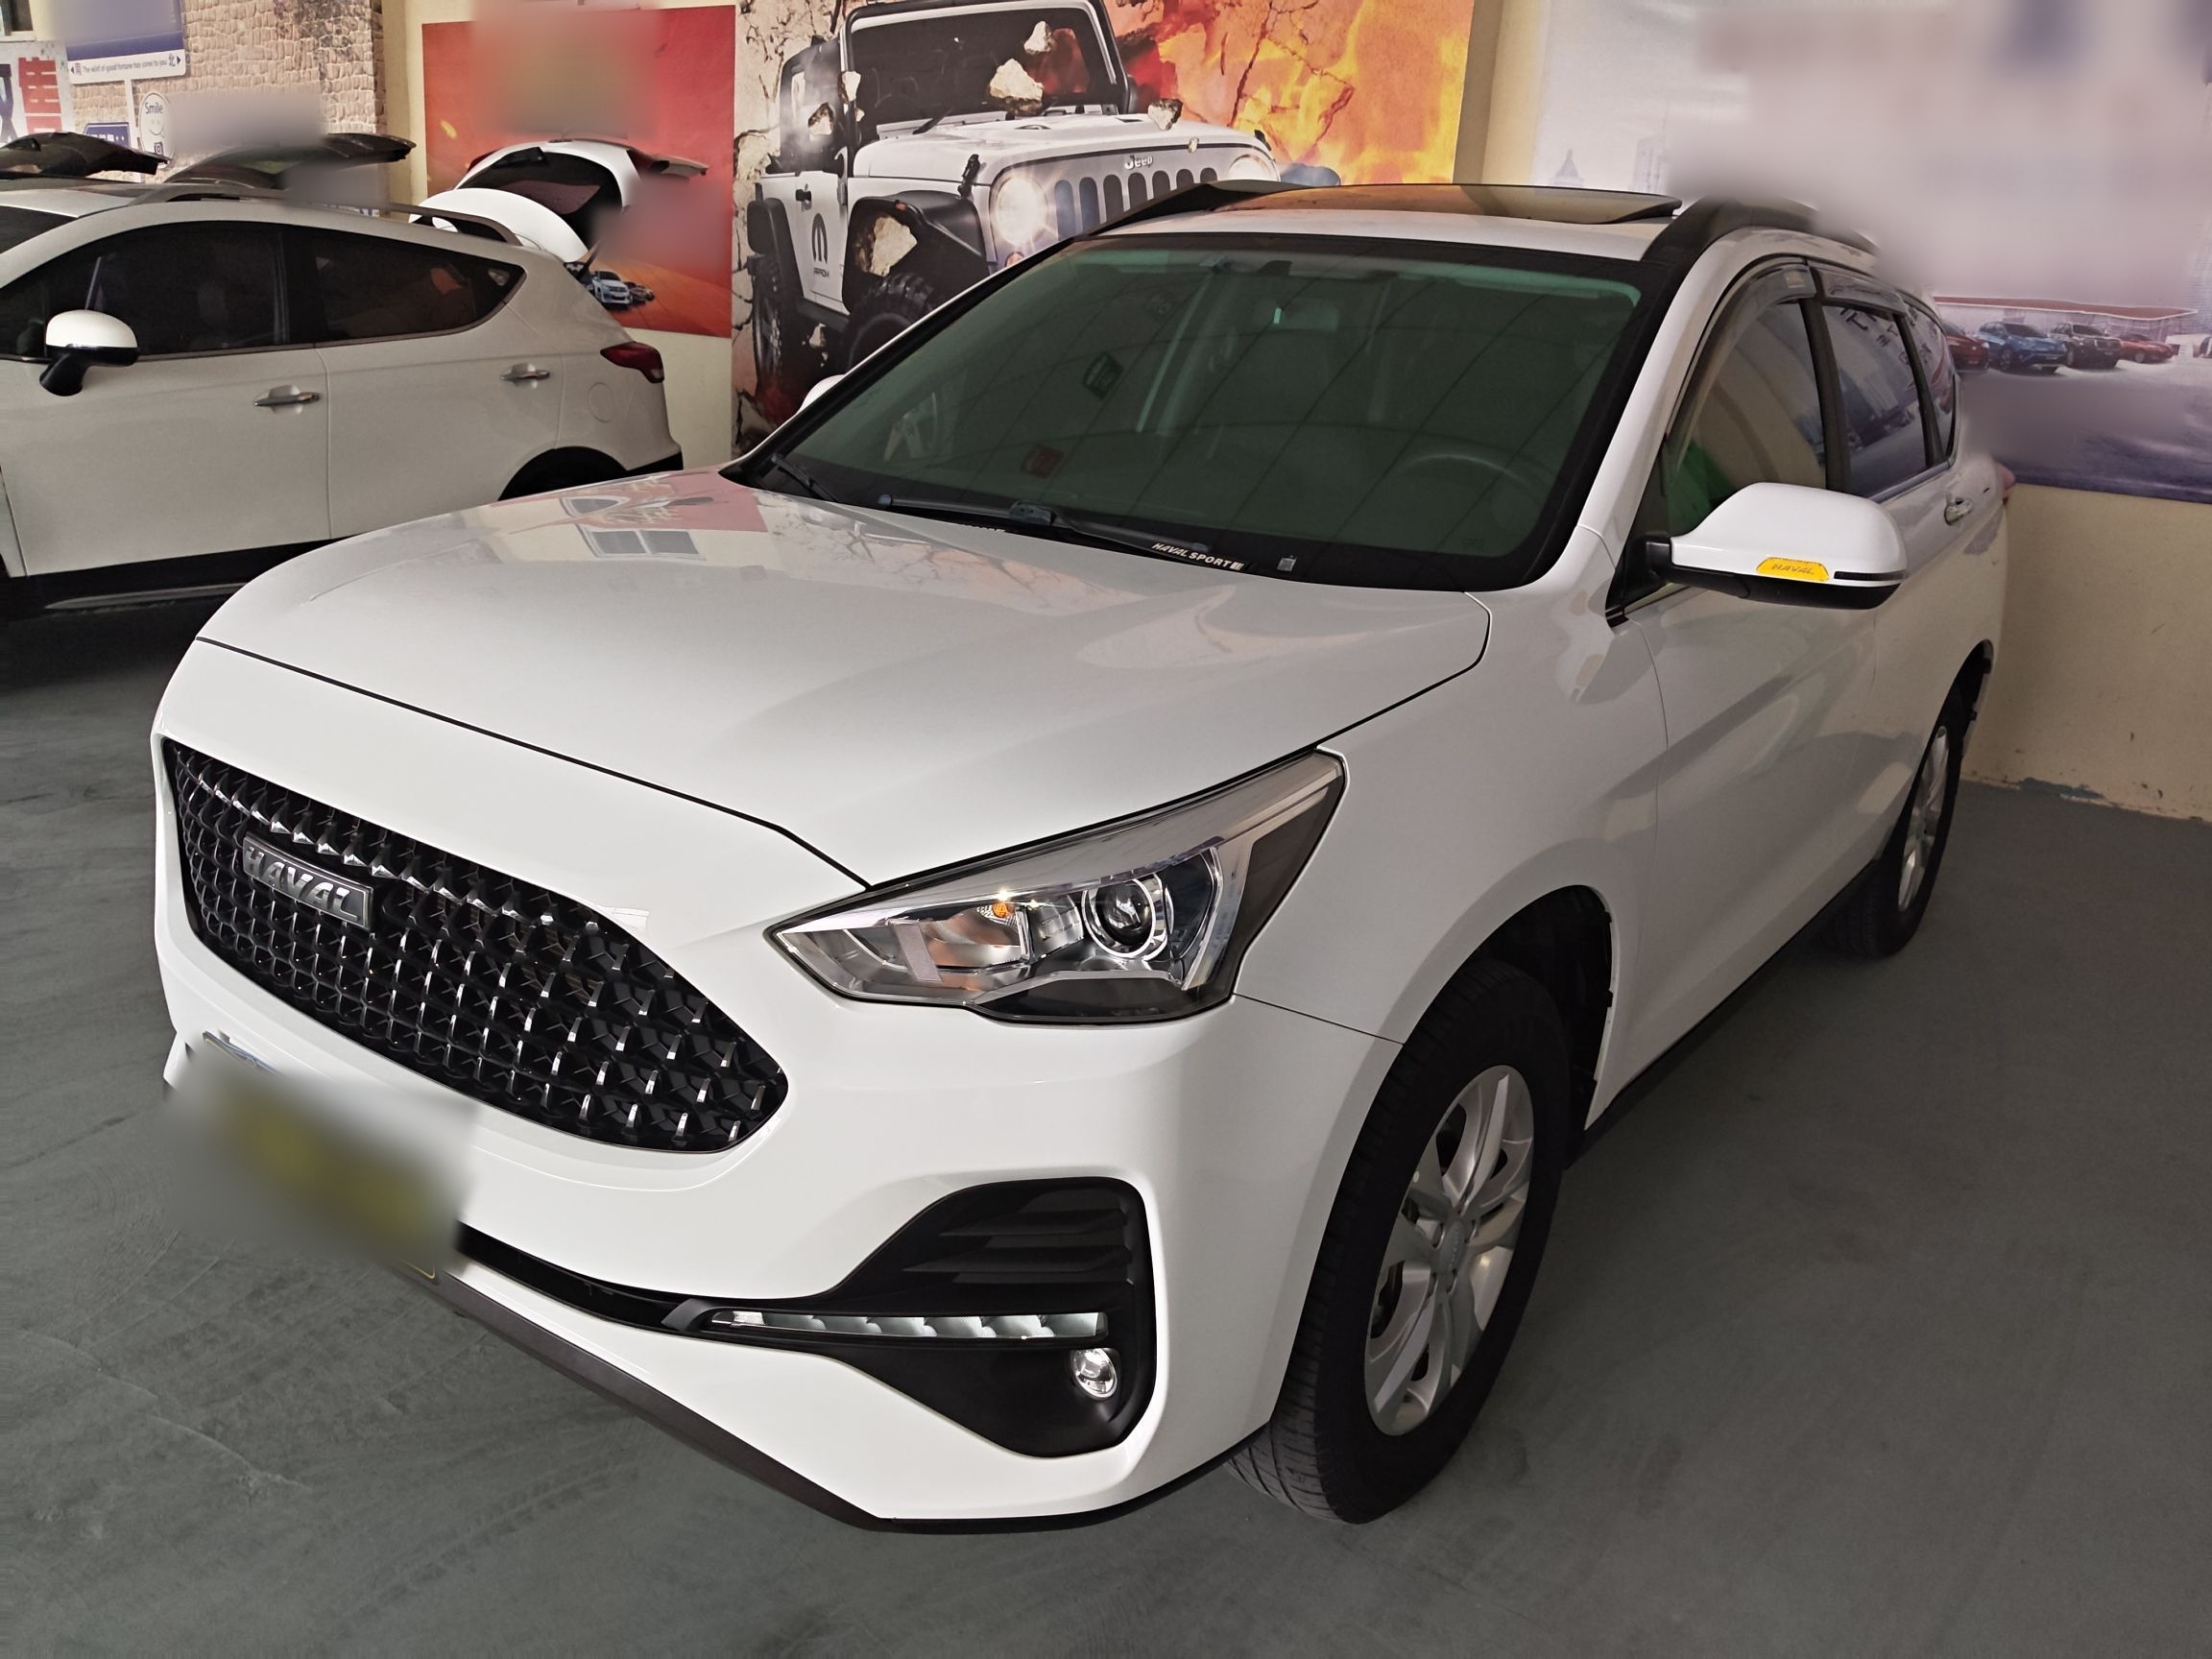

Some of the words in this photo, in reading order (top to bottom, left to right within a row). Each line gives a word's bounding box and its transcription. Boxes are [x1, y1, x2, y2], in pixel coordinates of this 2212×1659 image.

[145, 101, 163, 114] Smile
[1124, 154, 1154, 170] Jeep
[1152, 542, 1188, 558] HAVAL
[1189, 551, 1231, 567] SPORT
[1771, 563, 1815, 575] HAVAL
[244, 845, 359, 923] HAVAL
